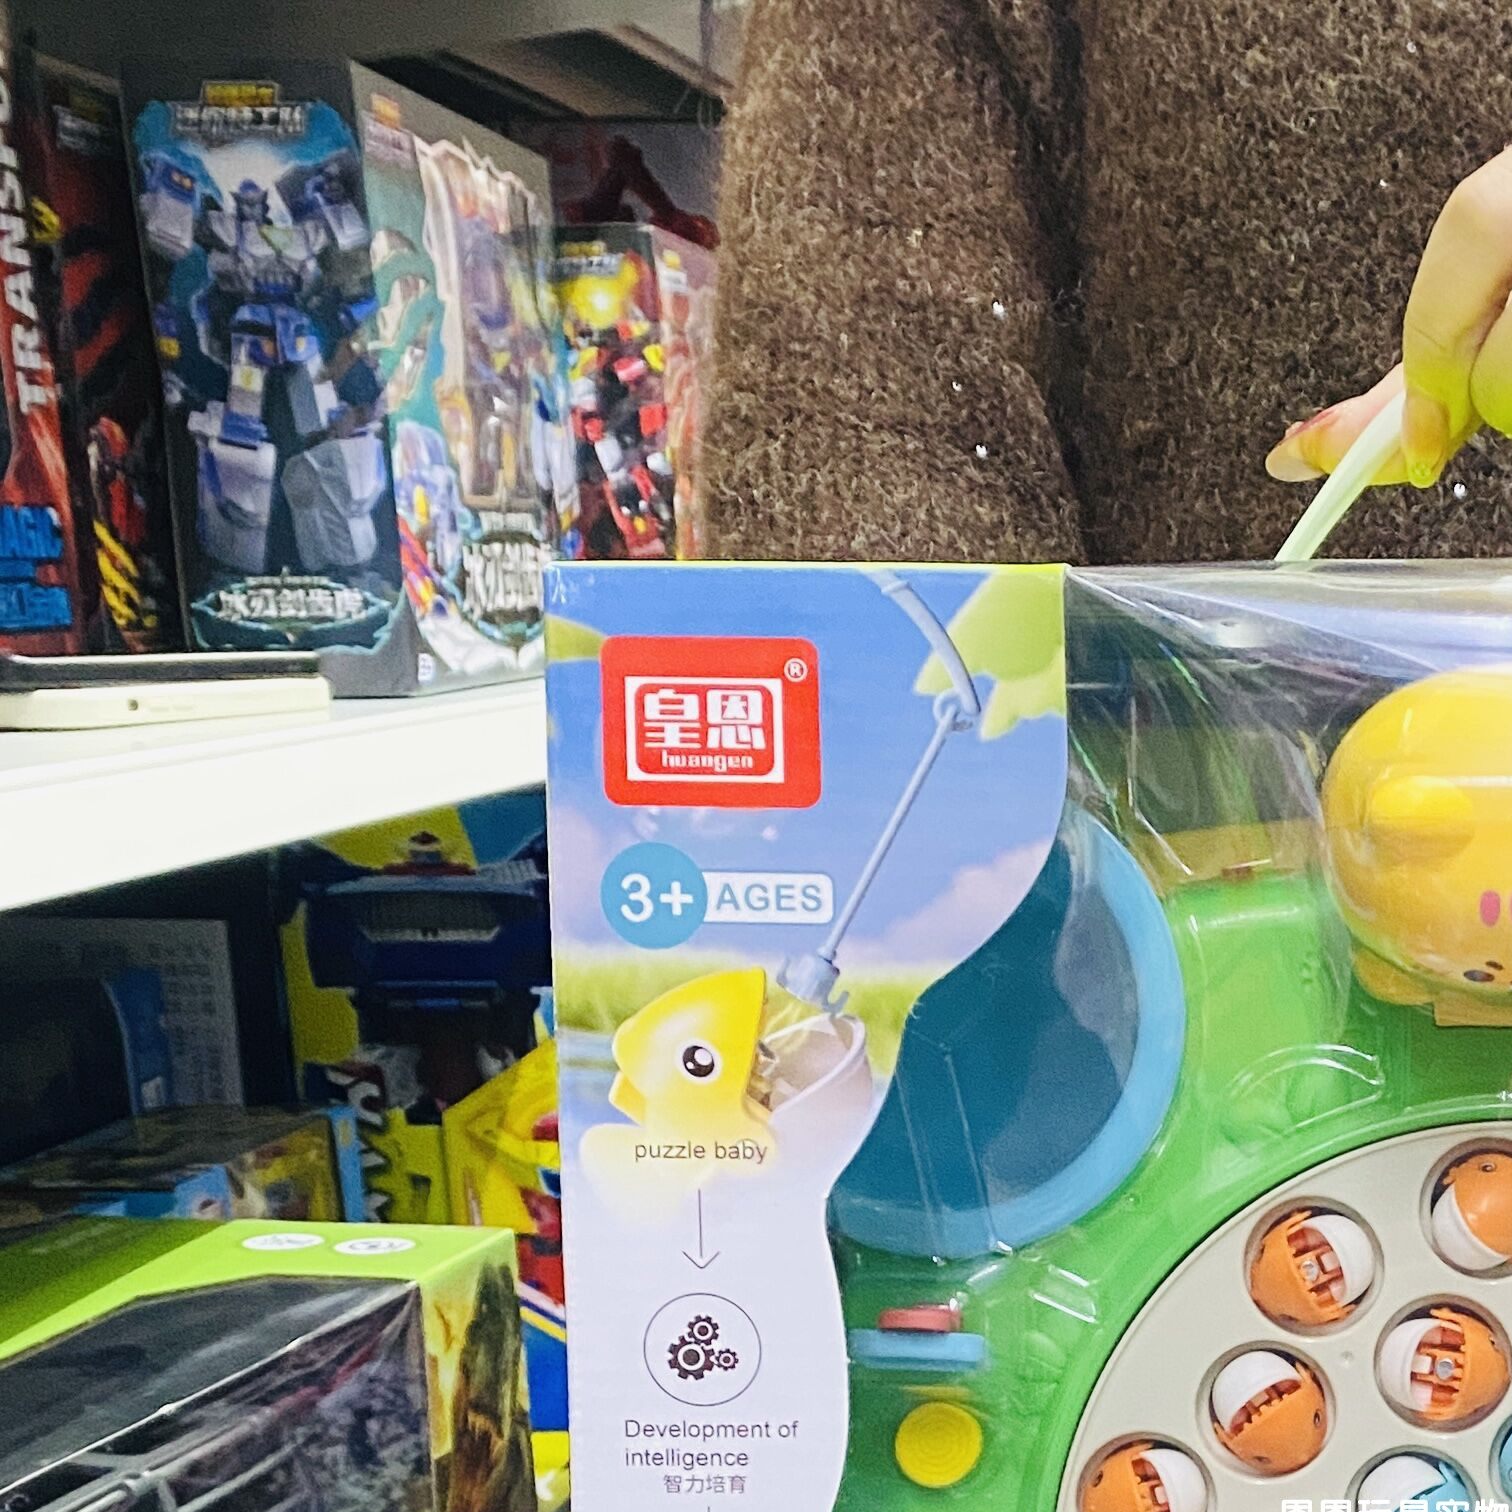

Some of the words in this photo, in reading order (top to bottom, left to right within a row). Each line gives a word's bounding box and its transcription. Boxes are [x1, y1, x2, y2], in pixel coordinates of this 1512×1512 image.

[642, 688, 767, 750] 皇恩
[661, 750, 754, 772] huangen
[619, 873, 694, 923] 3+
[715, 883, 823, 912] AGES
[634, 1140, 706, 1163] puzzle
[714, 1141, 768, 1164] baby
[624, 1419, 771, 1442] Development
[777, 1419, 800, 1439] of
[625, 1447, 750, 1471] intelligence
[663, 1474, 747, 1495] 智力培育
